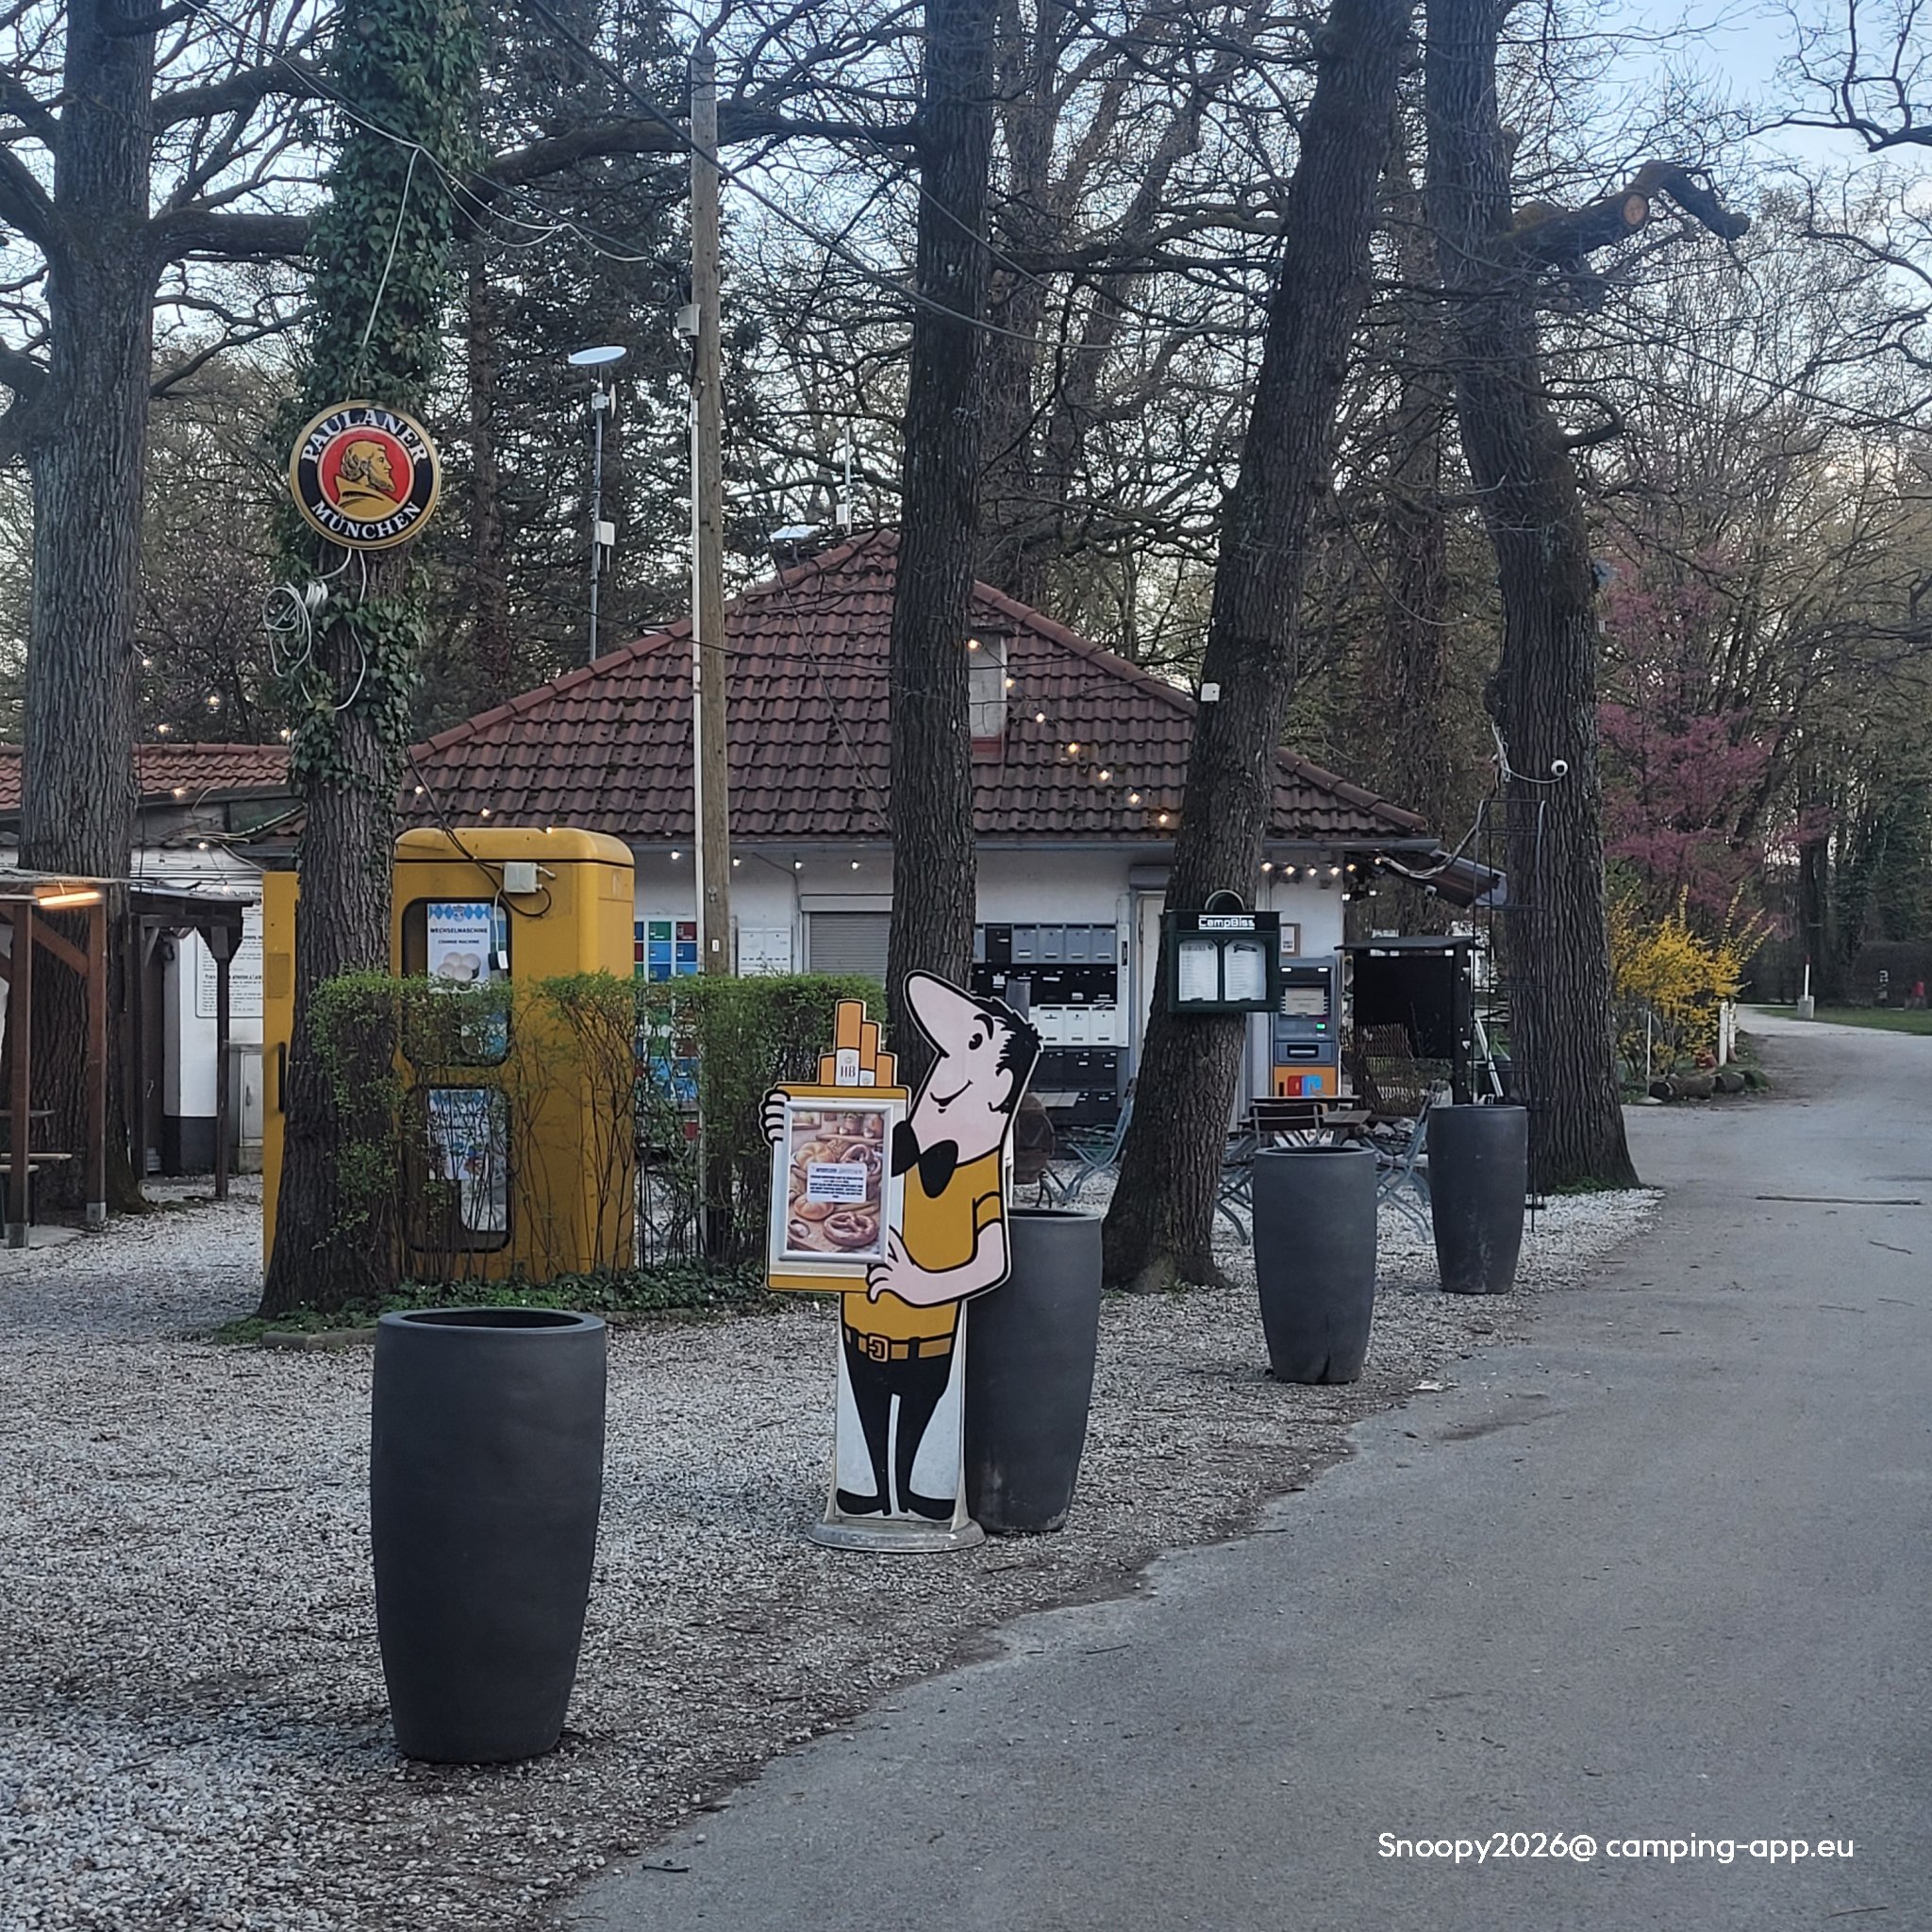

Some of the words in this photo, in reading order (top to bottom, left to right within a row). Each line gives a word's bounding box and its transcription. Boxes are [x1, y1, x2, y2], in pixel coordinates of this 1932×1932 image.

[301, 408, 428, 465] PAULANER
[311, 499, 421, 540] MÜNCHEN
[841, 1065, 856, 1077] HB
